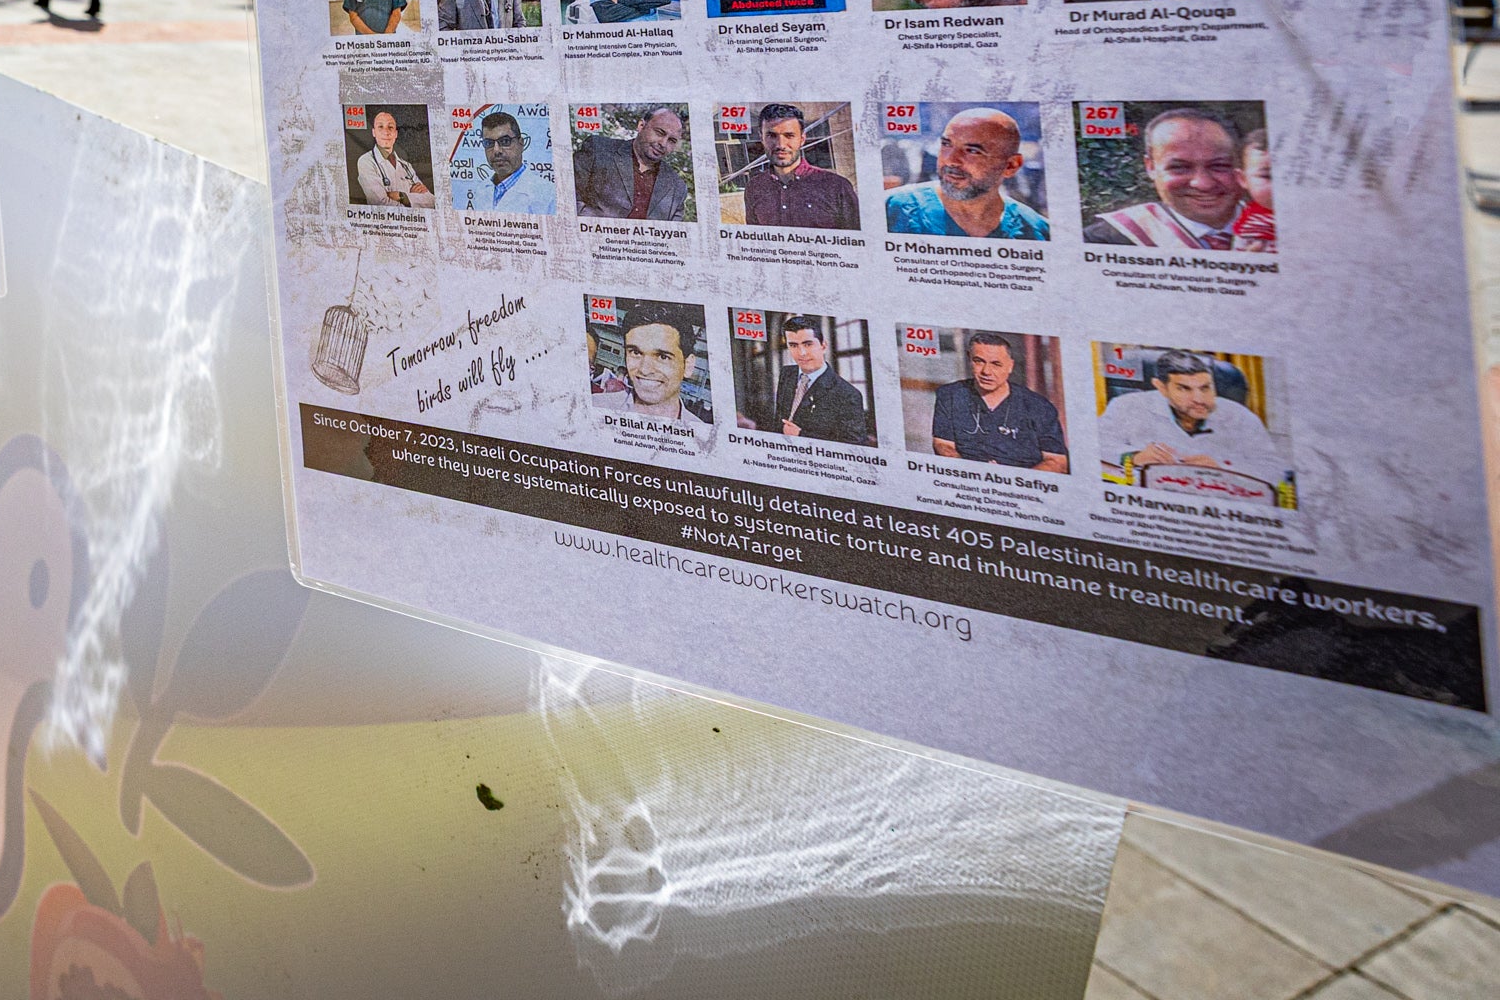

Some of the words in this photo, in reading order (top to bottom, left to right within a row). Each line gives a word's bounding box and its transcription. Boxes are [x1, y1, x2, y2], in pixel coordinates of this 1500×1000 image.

[718, 24, 731, 34] Dr
[734, 22, 775, 33] Khaled
[779, 21, 826, 34] Seyam
[884, 18, 901, 29] Dr
[905, 16, 939, 29] Isam
[943, 15, 1004, 27] Redwan
[563, 31, 574, 39] Dr
[576, 29, 623, 39] Mahmoud
[626, 27, 673, 39] Al-Hallaq
[887, 105, 915, 117] 267
[887, 121, 918, 133] Days
[580, 223, 593, 232] Dr
[595, 224, 629, 236] Ameer
[633, 226, 687, 239] Al-Tayyan
[720, 230, 732, 239] Dr
[735, 230, 783, 243] Abdullah
[787, 233, 865, 247] Abu-Al-Jidian
[885, 241, 902, 252] Dr
[905, 242, 992, 258] Mohammed
[997, 246, 1043, 261] Obaid
[387, 333, 463, 376] Tomorrow,
[468, 297, 526, 344] freedom
[906, 327, 933, 340] 201
[906, 342, 937, 356] Days
[417, 384, 451, 413] birds
[458, 364, 485, 395] will
[491, 347, 516, 387] fly
[907, 461, 923, 472] Dr
[928, 464, 979, 480] Hussam
[984, 472, 1008, 484] Abu
[1012, 475, 1059, 494] Safiya
[313, 413, 347, 431] Since
[349, 419, 401, 440] October
[404, 429, 416, 446] 7,
[419, 432, 457, 454] 2023,
[461, 439, 506, 460] Israeli
[509, 448, 600, 477] Occupation
[605, 466, 661, 488] Forces
[666, 477, 764, 512] unlawfully
[769, 491, 857, 527] detained
[862, 508, 884, 530] at
[889, 513, 941, 542] least
[946, 526, 994, 550] 405
[1000, 535, 1139, 578] Palestinian
[1144, 554, 1297, 605] healthcare
[1303, 588, 1447, 633] workers.
[392, 447, 435, 466] where
[438, 454, 469, 478] they
[472, 465, 510, 482] were
[513, 469, 629, 508] systematically
[633, 493, 706, 520] exposed
[711, 504, 729, 522] to
[734, 511, 841, 547] systematic
[845, 530, 923, 565] torture
[927, 547, 972, 574] and
[977, 557, 1103, 597] inhumane
[1108, 581, 1254, 626] treatment.
[681, 524, 802, 563] #NotATarget
[554, 529, 972, 642] www.healthcareworkerswatch.org
